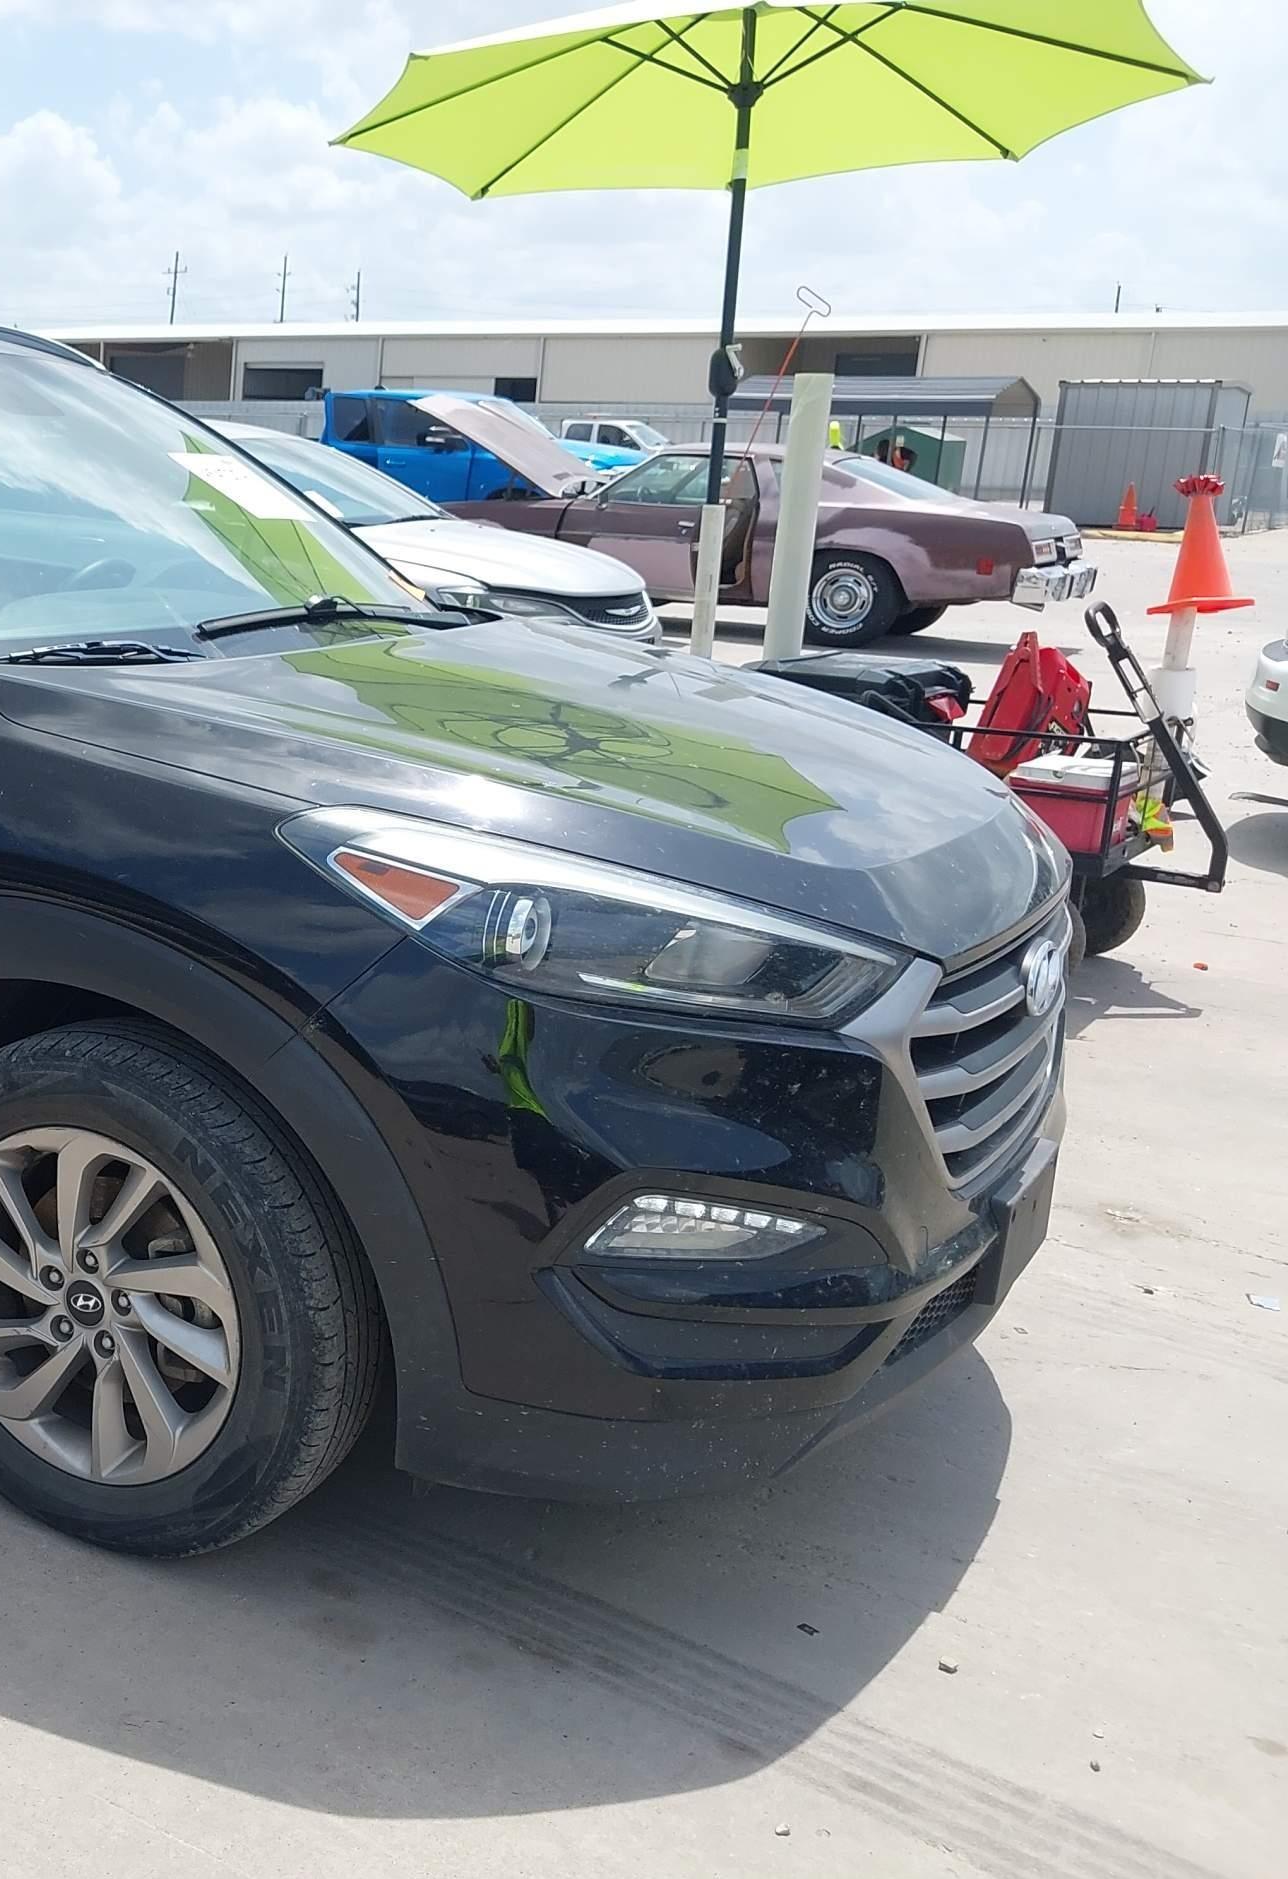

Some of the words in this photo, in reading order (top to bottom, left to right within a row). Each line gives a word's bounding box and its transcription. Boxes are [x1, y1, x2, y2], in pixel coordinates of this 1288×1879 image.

[829, 562, 864, 573] RADIAL
[821, 622, 863, 635] COOPER
[172, 1136, 289, 1394] NEXEN
